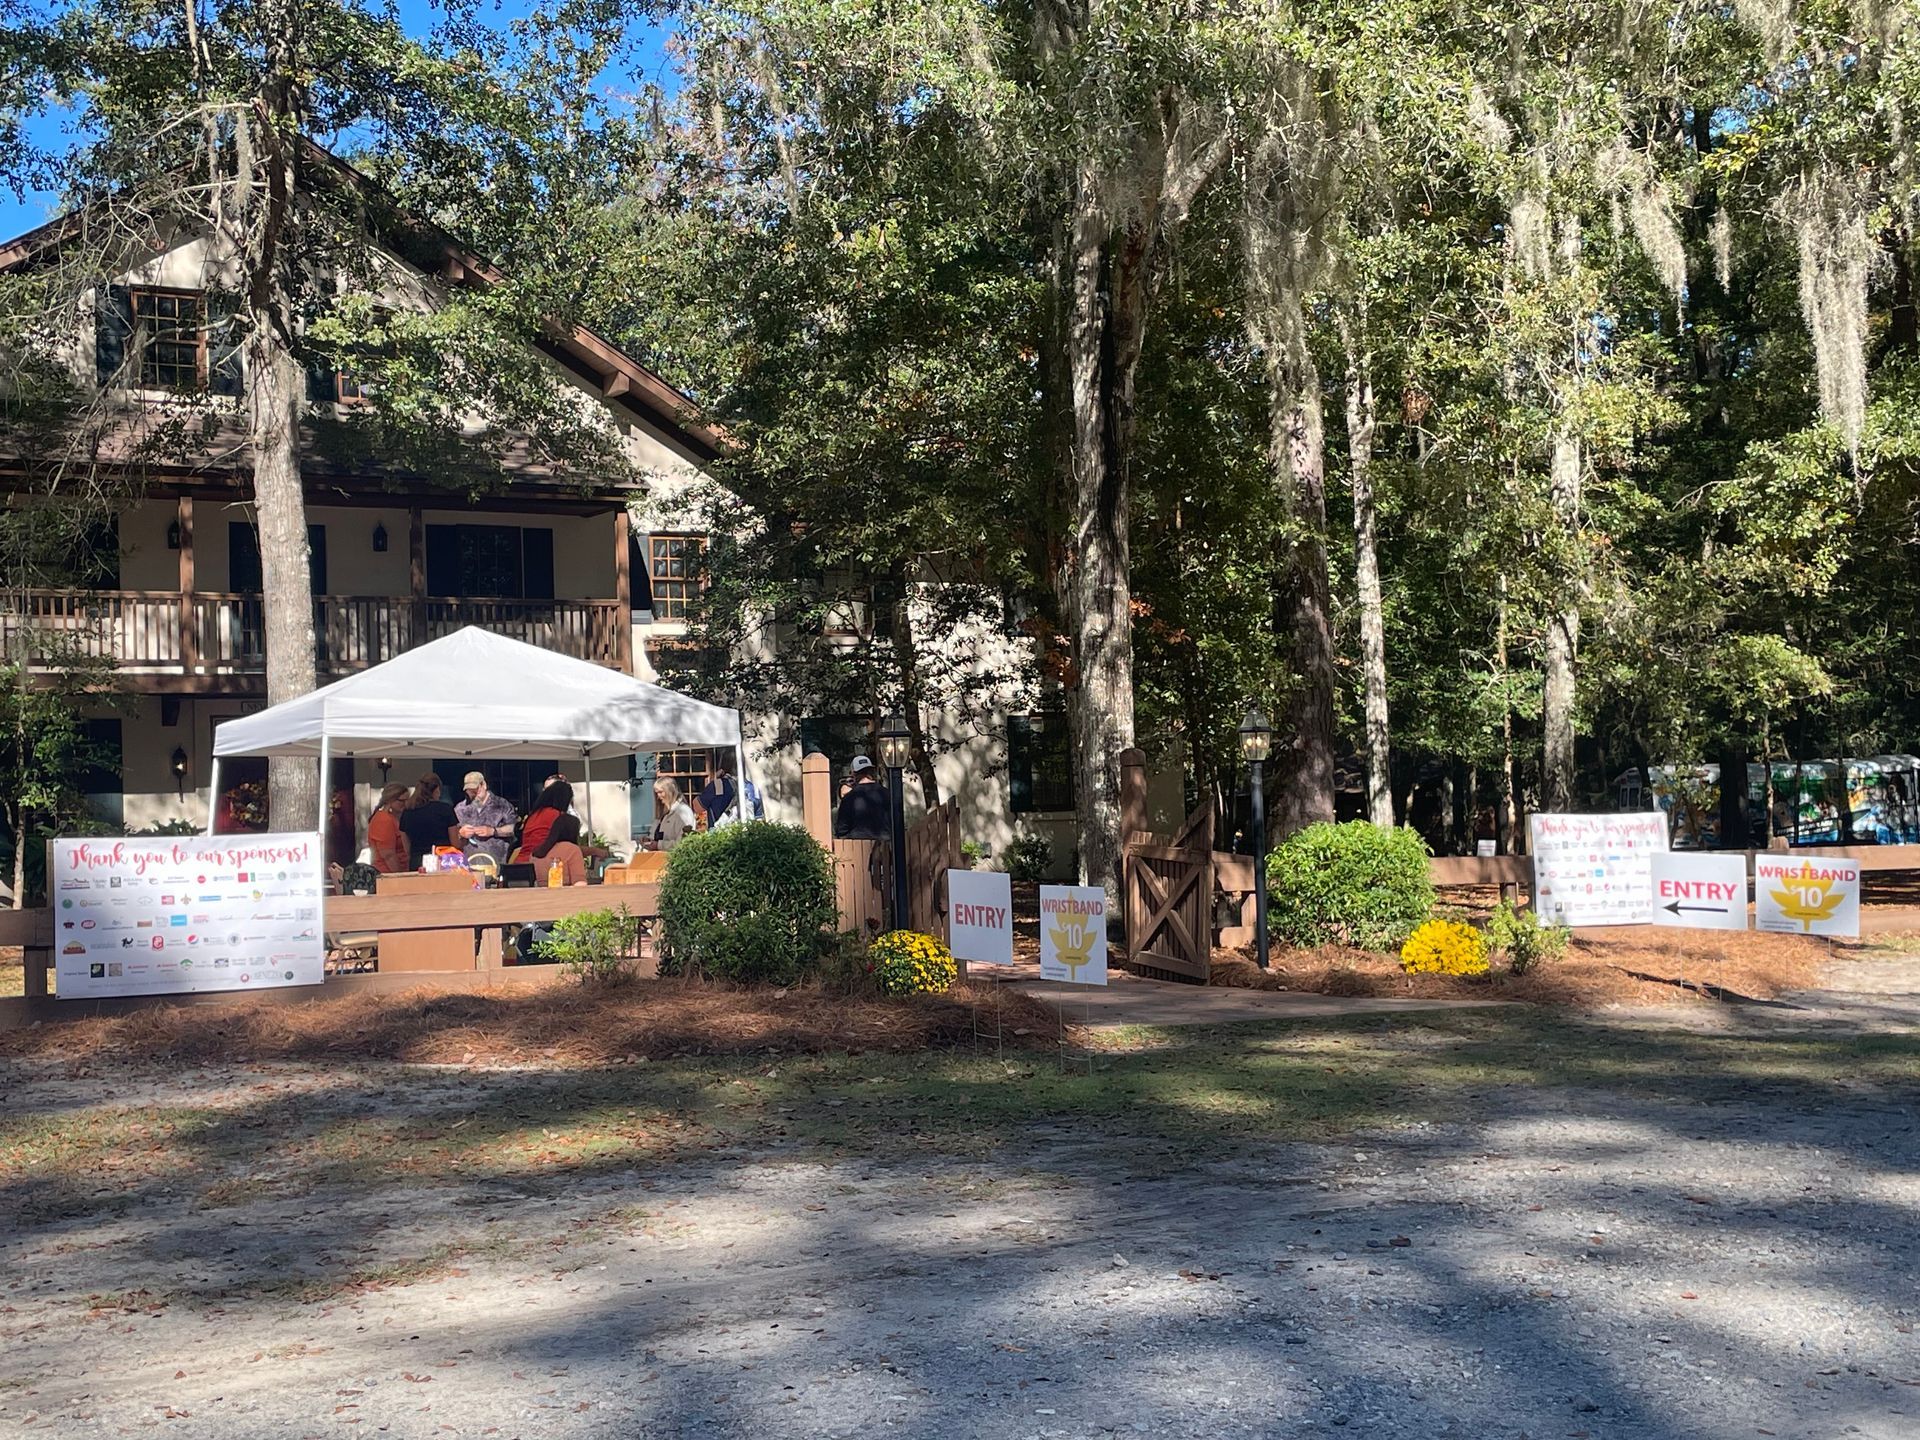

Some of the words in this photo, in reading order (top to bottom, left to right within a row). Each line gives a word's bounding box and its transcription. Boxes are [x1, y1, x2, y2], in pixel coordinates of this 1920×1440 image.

[1538, 817, 1569, 836] Thank
[68, 842, 129, 871] Thank
[133, 851, 167, 875] you
[172, 844, 191, 866] to
[196, 848, 225, 867] our
[227, 843, 308, 869] sponsors!
[1758, 865, 1857, 882] WRISTBAND
[1659, 880, 1738, 901] ENTRY
[1790, 885, 1823, 908] $10
[954, 903, 1006, 929] ENTRY
[1041, 898, 1103, 916] WRISTBAND
